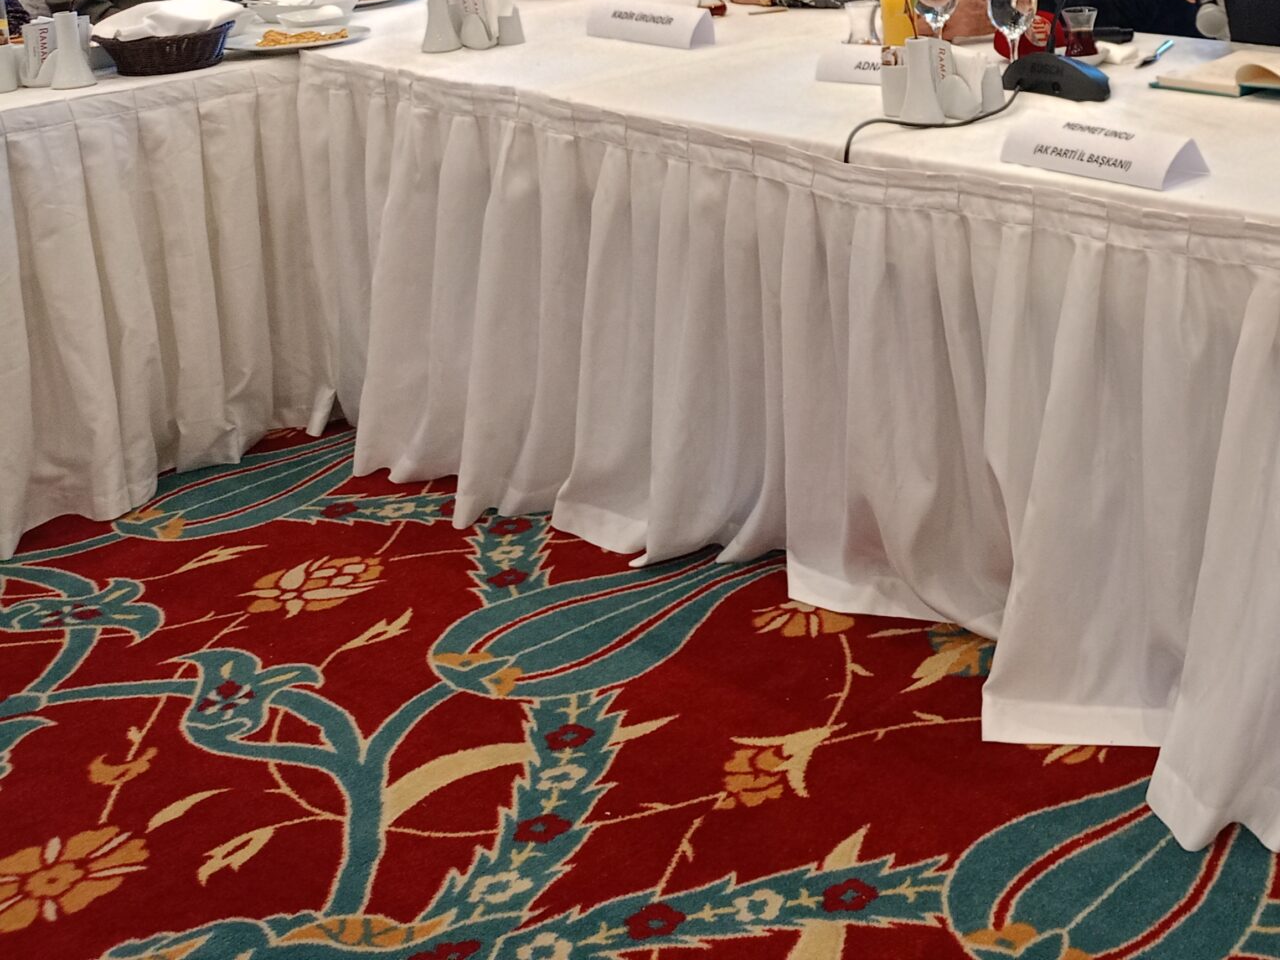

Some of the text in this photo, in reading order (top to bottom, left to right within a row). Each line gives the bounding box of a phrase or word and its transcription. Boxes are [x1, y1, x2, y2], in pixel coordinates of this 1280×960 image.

[938, 47, 946, 80] RAMA
[1063, 122, 1105, 135] MEHMET
[1033, 143, 1051, 155] (AK
